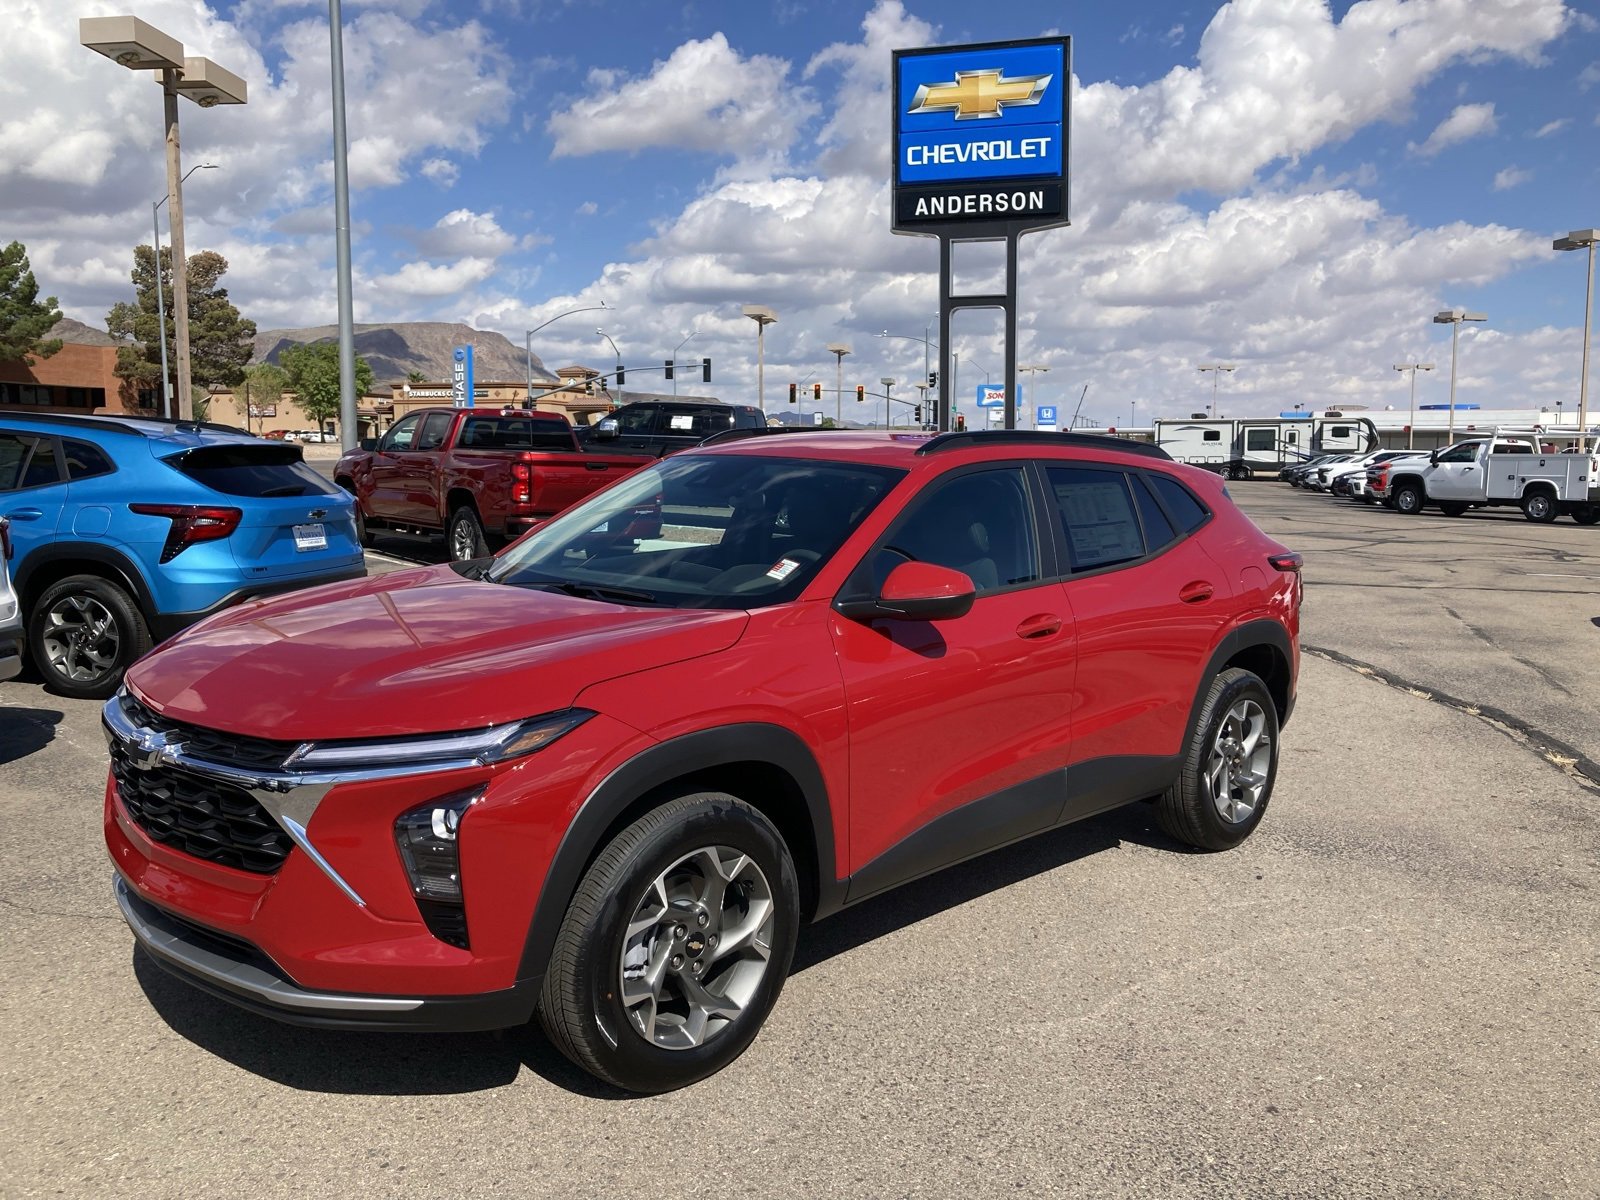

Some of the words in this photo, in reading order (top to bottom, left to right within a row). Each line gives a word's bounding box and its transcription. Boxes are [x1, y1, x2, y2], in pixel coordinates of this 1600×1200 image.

[907, 137, 1051, 166] CHEVROLET
[915, 190, 1044, 216] ANDERSON
[408, 390, 446, 398] STARBUCKS
[454, 363, 465, 408] CHASE
